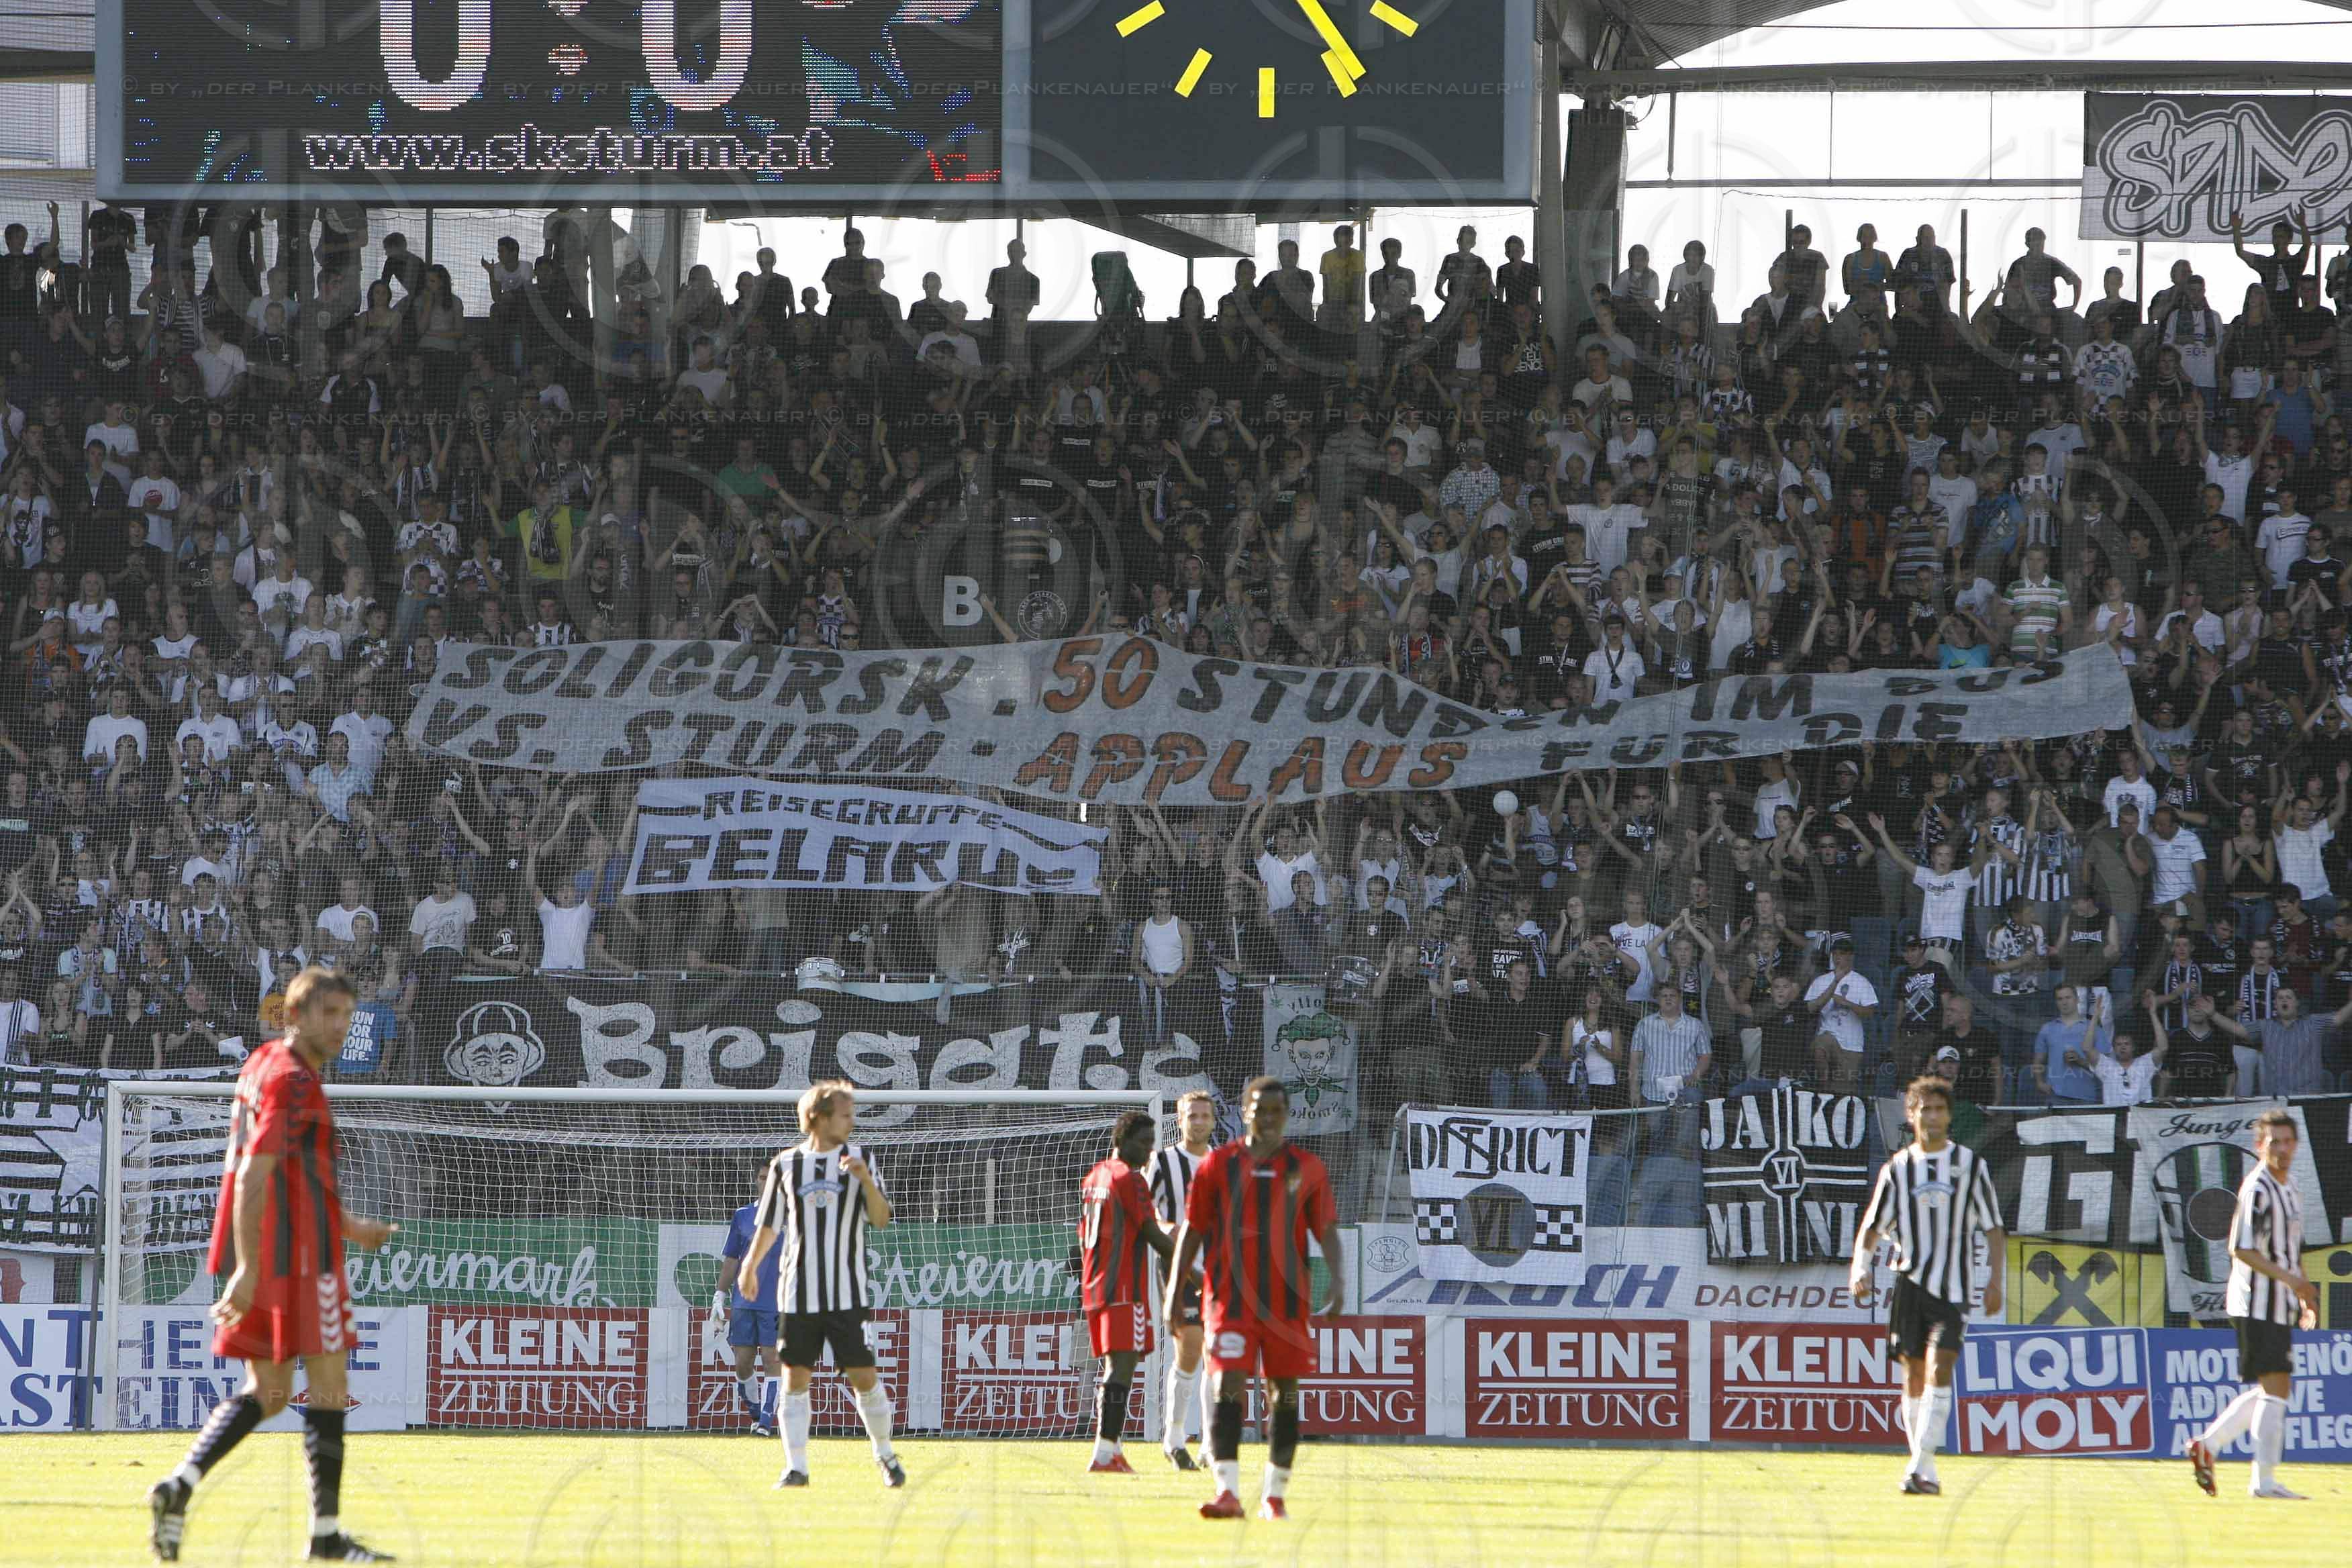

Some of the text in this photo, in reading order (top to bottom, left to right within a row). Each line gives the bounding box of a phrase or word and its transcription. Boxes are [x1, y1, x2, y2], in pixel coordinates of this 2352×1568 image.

[301, 124, 834, 173] www.sksturm.at
[441, 642, 975, 721] SOLIGORSK
[1043, 637, 1160, 714] 50
[1690, 675, 1812, 720] IM
[422, 698, 555, 763] VS.
[601, 709, 946, 773] STURM
[1013, 731, 1468, 802] APPLAUS
[1801, 702, 1969, 744] DIE
[703, 789, 1004, 830] REISEGRUPPE
[635, 828, 1077, 887] BELARUS
[342, 1048, 369, 1061] LIFE.
[1408, 1116, 1586, 1180] DISTRICT
[1771, 1156, 1800, 1189] VI
[344, 1245, 599, 1306] eiermark
[440, 1319, 636, 1366] KLEINE
[1478, 1332, 1677, 1379] KLEINE
[1724, 1335, 1905, 1384] KLEIN
[1964, 1334, 2139, 1392] LIQUI
[2166, 1332, 2352, 1384] MOTENÖ
[0, 1373, 238, 1429] STEIN
[440, 1380, 636, 1414] ZEITUNG
[1477, 1393, 1680, 1428] ZEITUNG
[1967, 1395, 2146, 1453] MOLY
